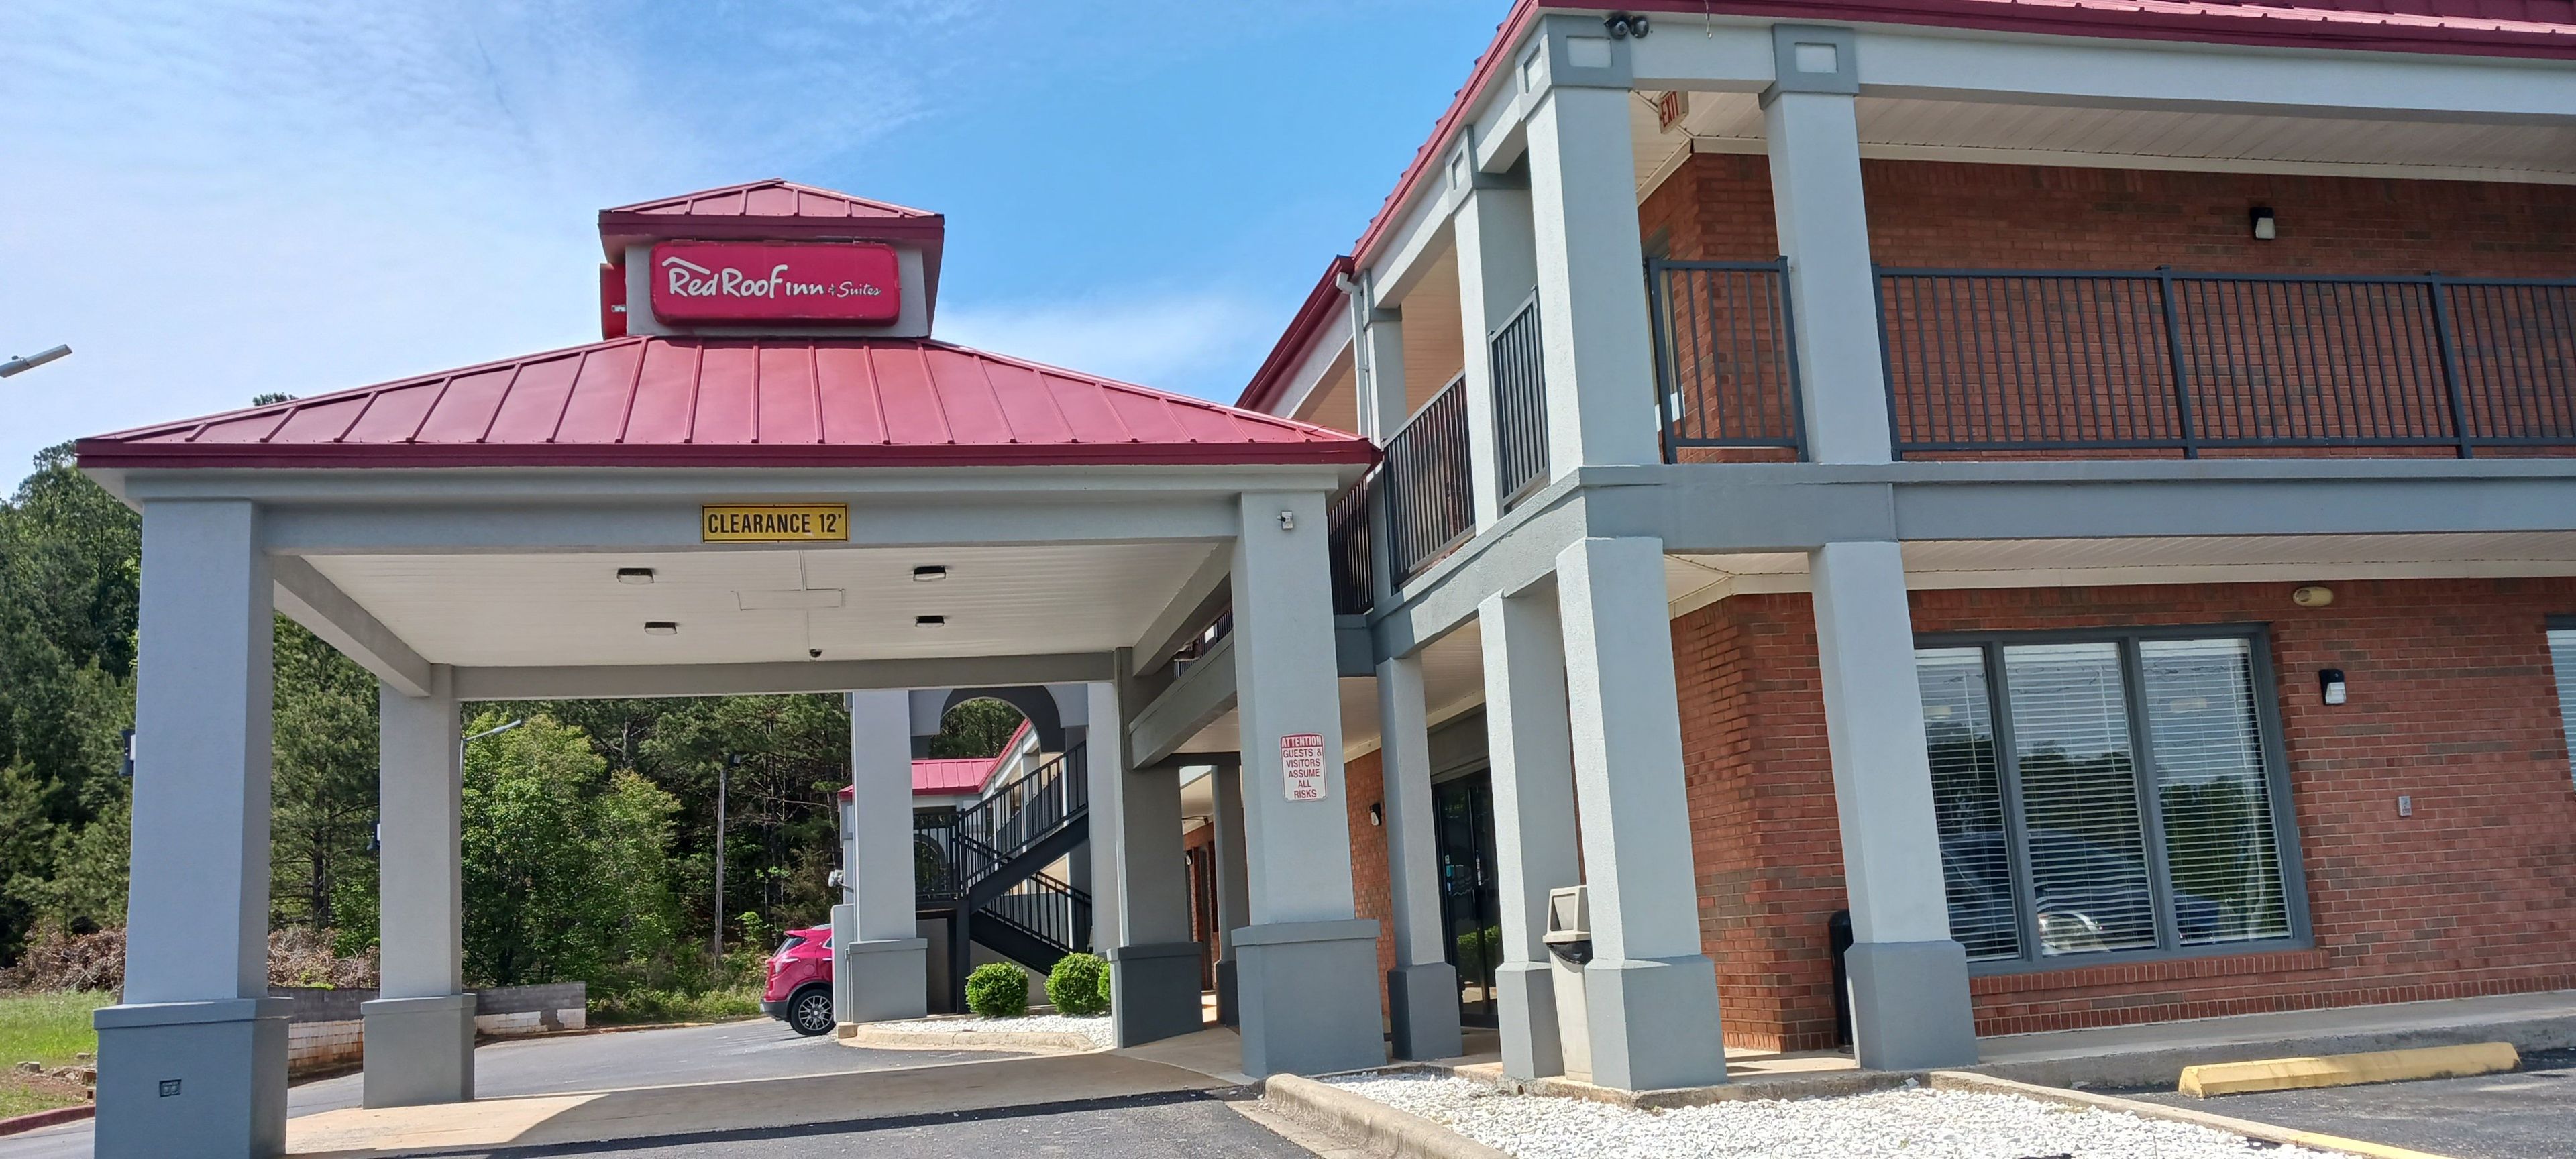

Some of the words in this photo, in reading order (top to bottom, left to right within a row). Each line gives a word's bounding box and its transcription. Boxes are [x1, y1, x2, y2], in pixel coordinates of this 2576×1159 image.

[1661, 91, 1679, 127] EXIT
[837, 281, 881, 298] Suites
[708, 514, 811, 533] CLEARANCE
[818, 514, 842, 533] 12'
[1281, 736, 1322, 747] ATTENTION
[1283, 749, 1313, 758] GUESTS
[1317, 748, 1322, 756] &
[1286, 759, 1320, 768] VISITORS
[1288, 769, 1320, 778] ASSUME
[1298, 779, 1311, 788] ALL
[1294, 789, 1317, 799] RISKS
